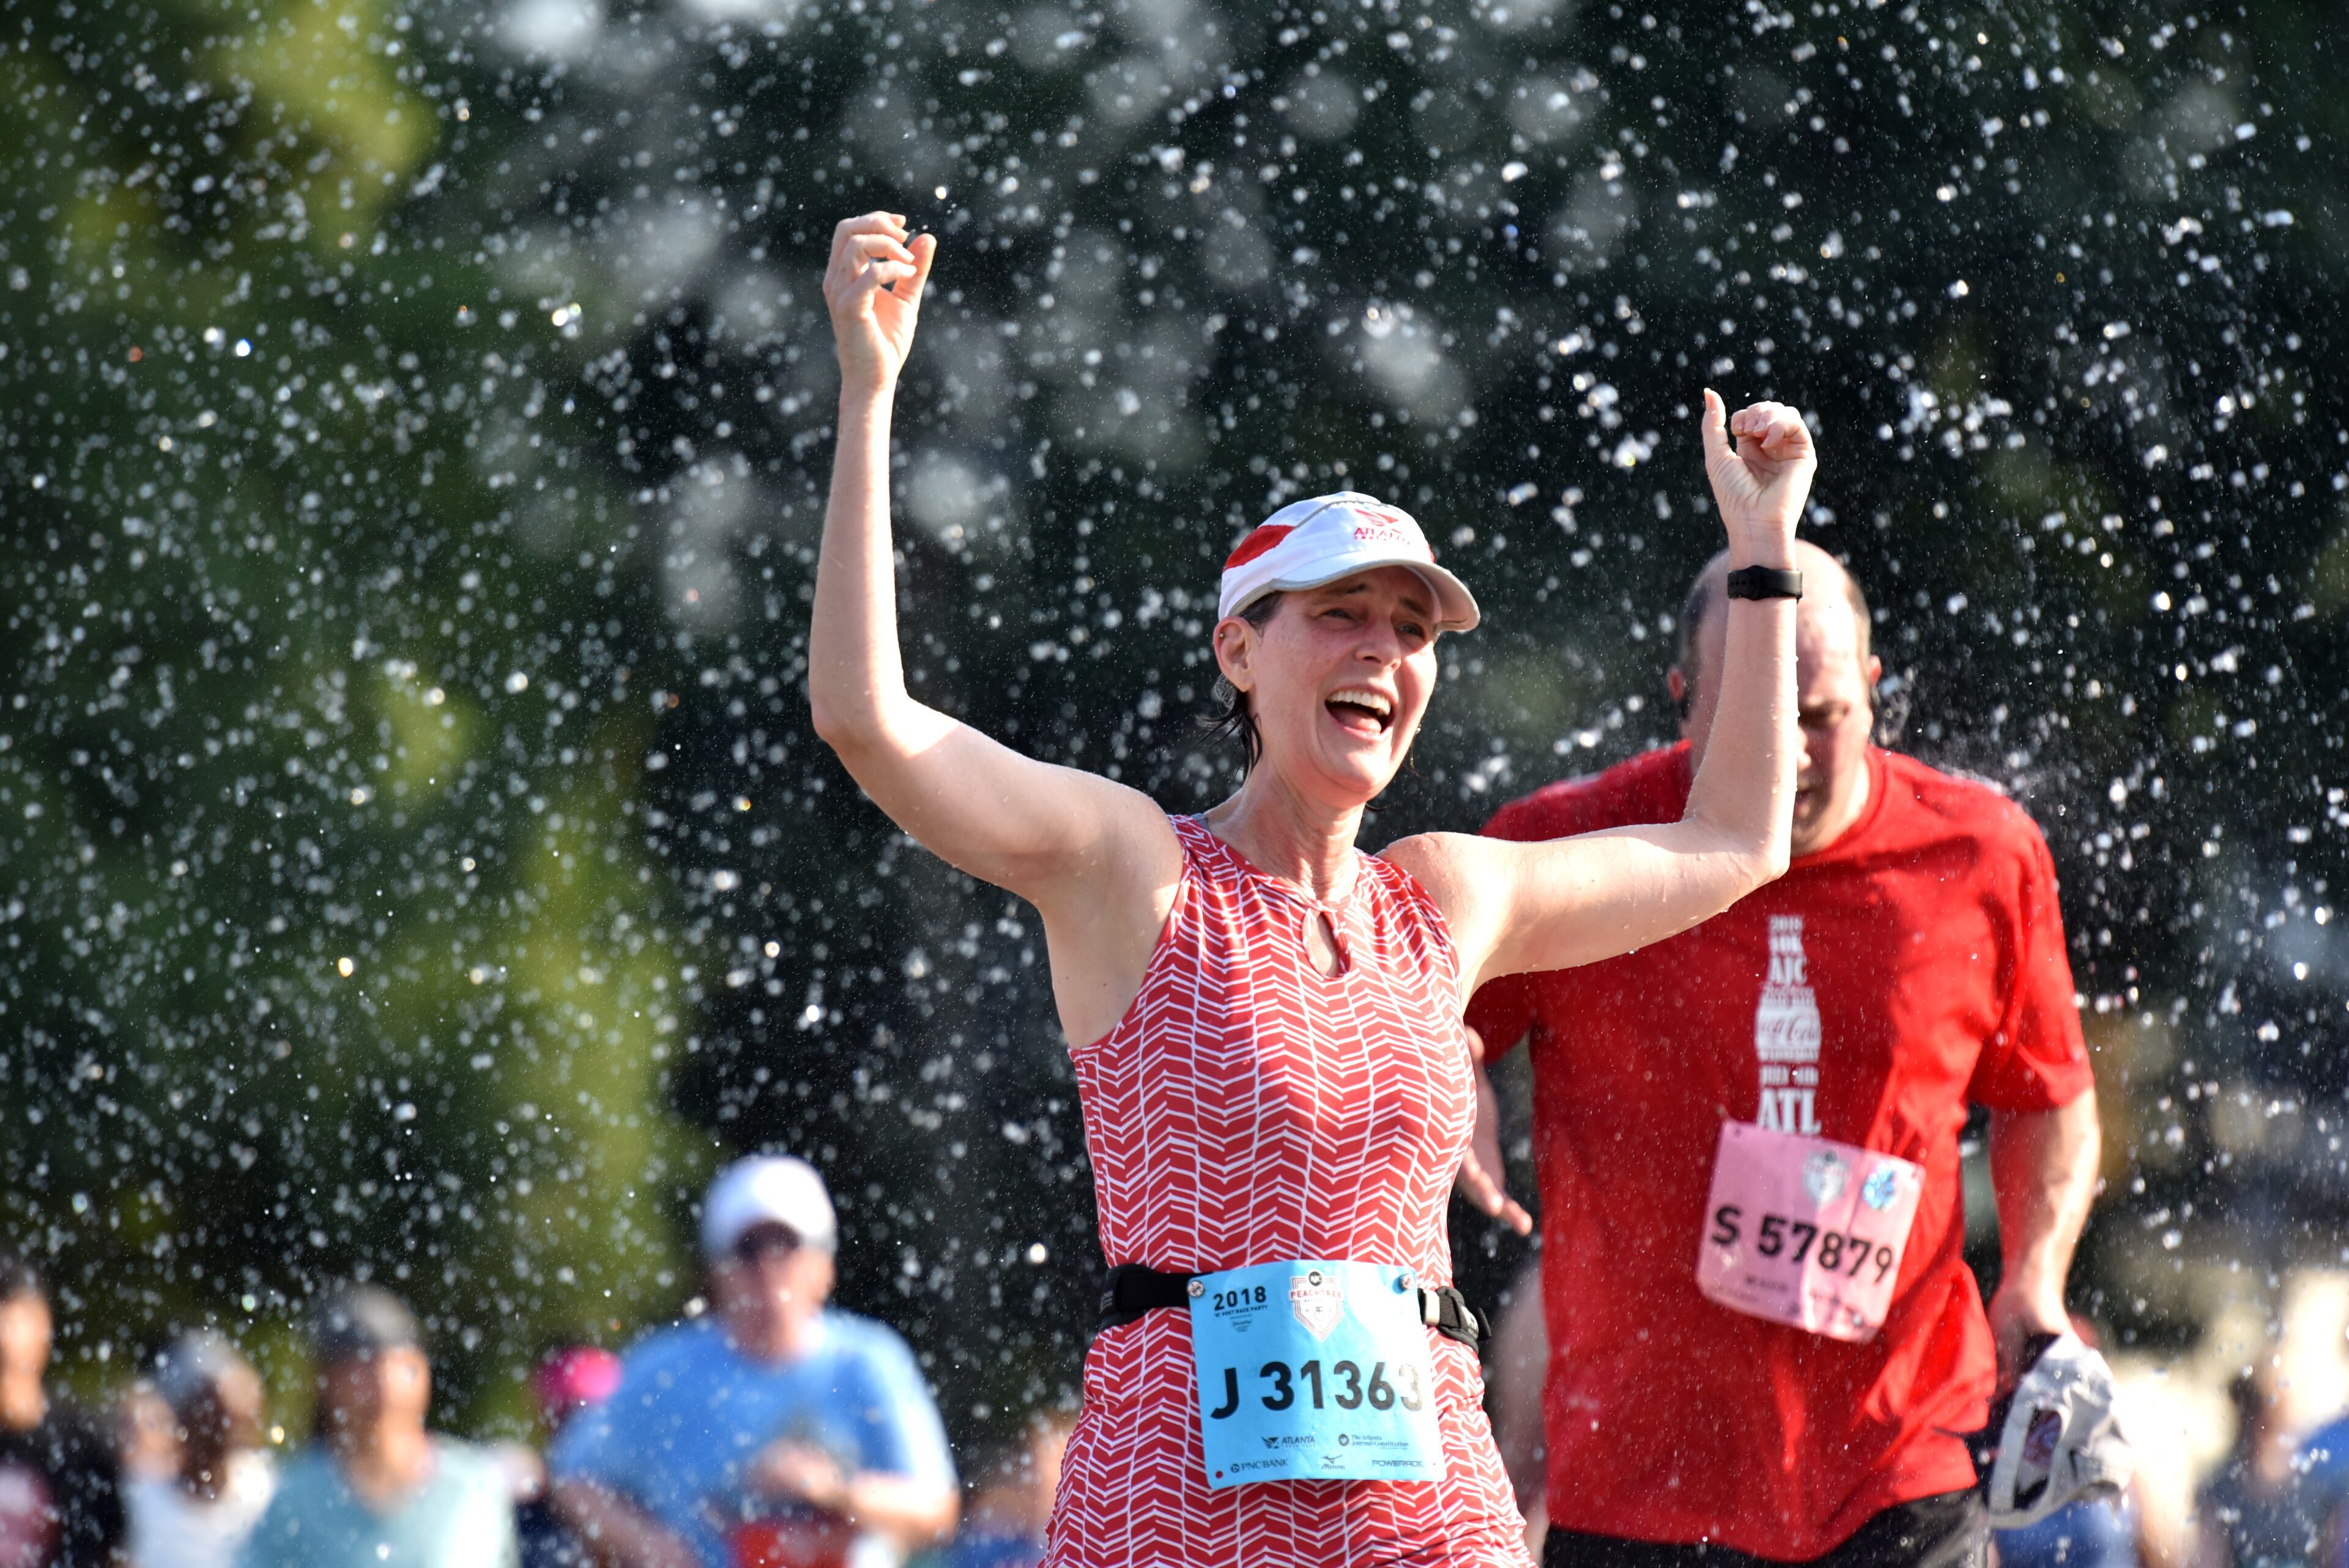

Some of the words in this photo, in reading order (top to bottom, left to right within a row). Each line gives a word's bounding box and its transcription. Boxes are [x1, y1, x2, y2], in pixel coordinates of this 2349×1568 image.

[1767, 956, 1808, 986] AJC
[1756, 1087, 1822, 1135] ATL
[1712, 1205, 1742, 1246] S
[1757, 1213, 1893, 1284] 57879
[1214, 1286, 1266, 1310] 2018
[1210, 1366, 1240, 1419] J
[1260, 1359, 1423, 1411] 31363
[1282, 1436, 1315, 1444] ATLANTA
